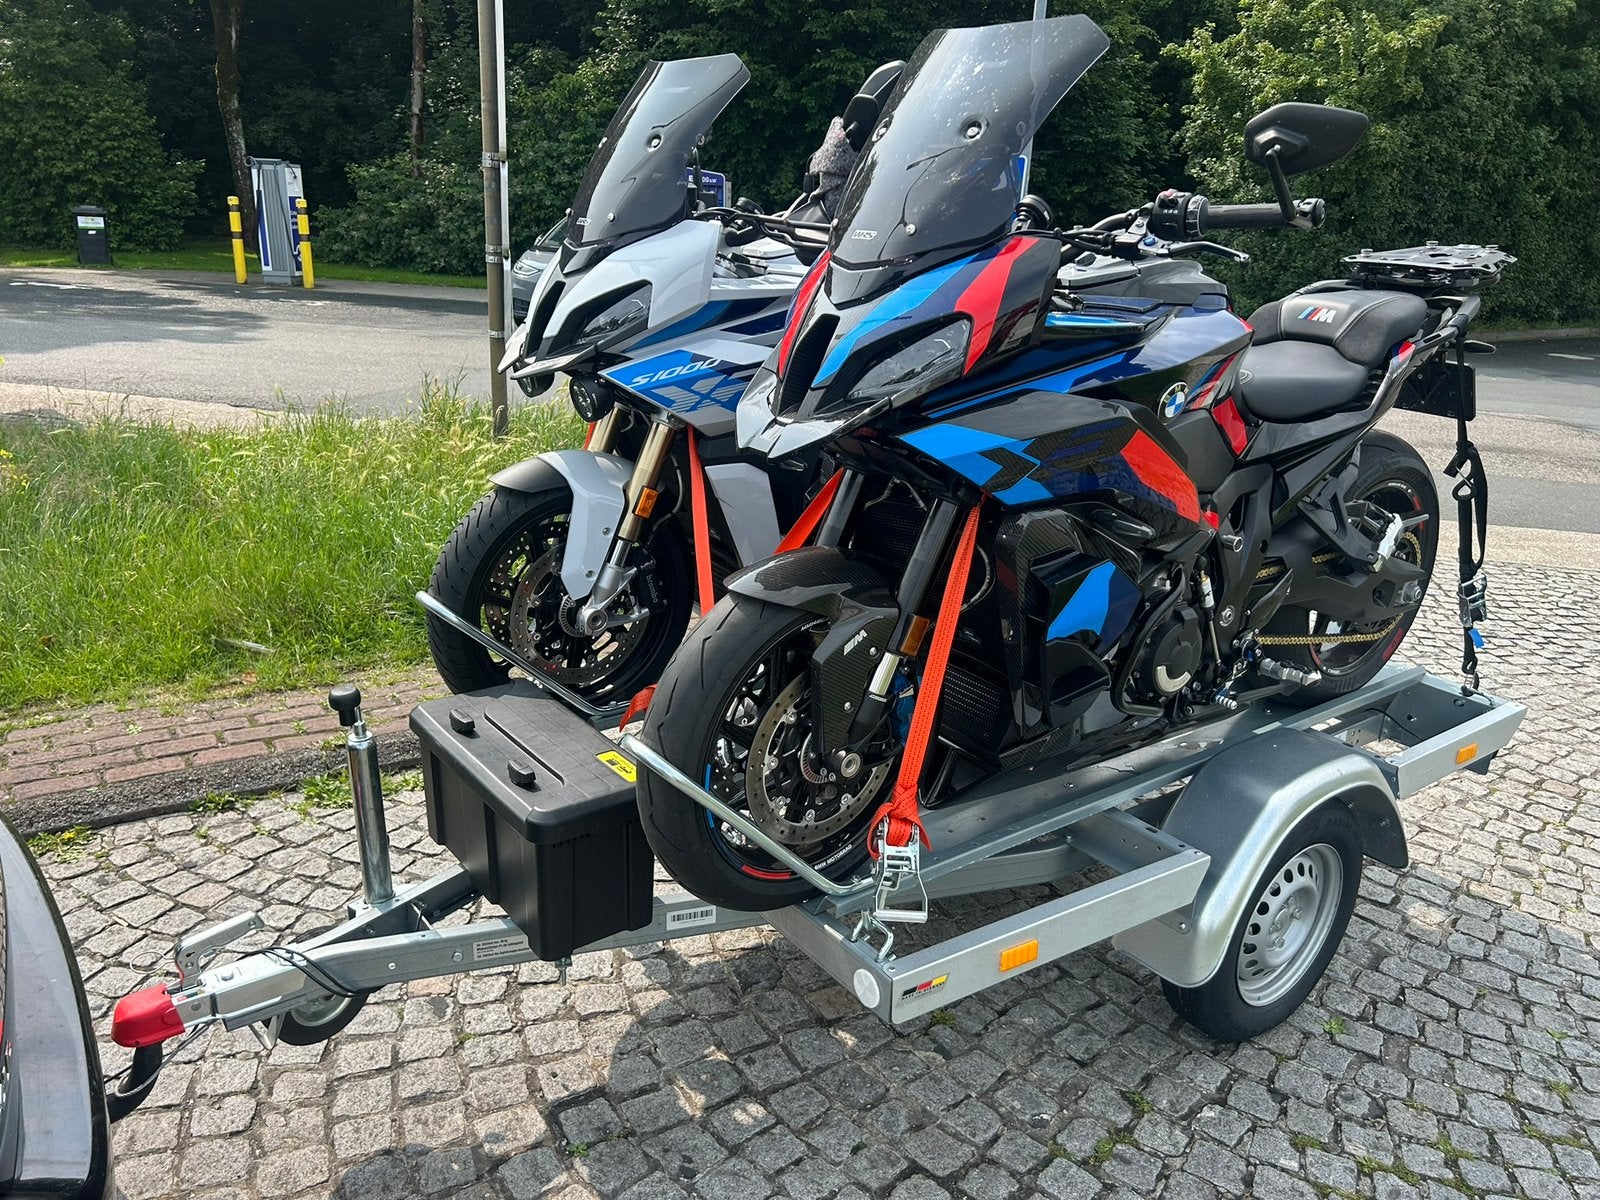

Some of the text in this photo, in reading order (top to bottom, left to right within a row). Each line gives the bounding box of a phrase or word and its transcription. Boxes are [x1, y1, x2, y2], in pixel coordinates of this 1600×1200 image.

[1311, 308, 1337, 323] M
[646, 573, 658, 603] brembo
[814, 844, 853, 870] BMW MOTORRAD
